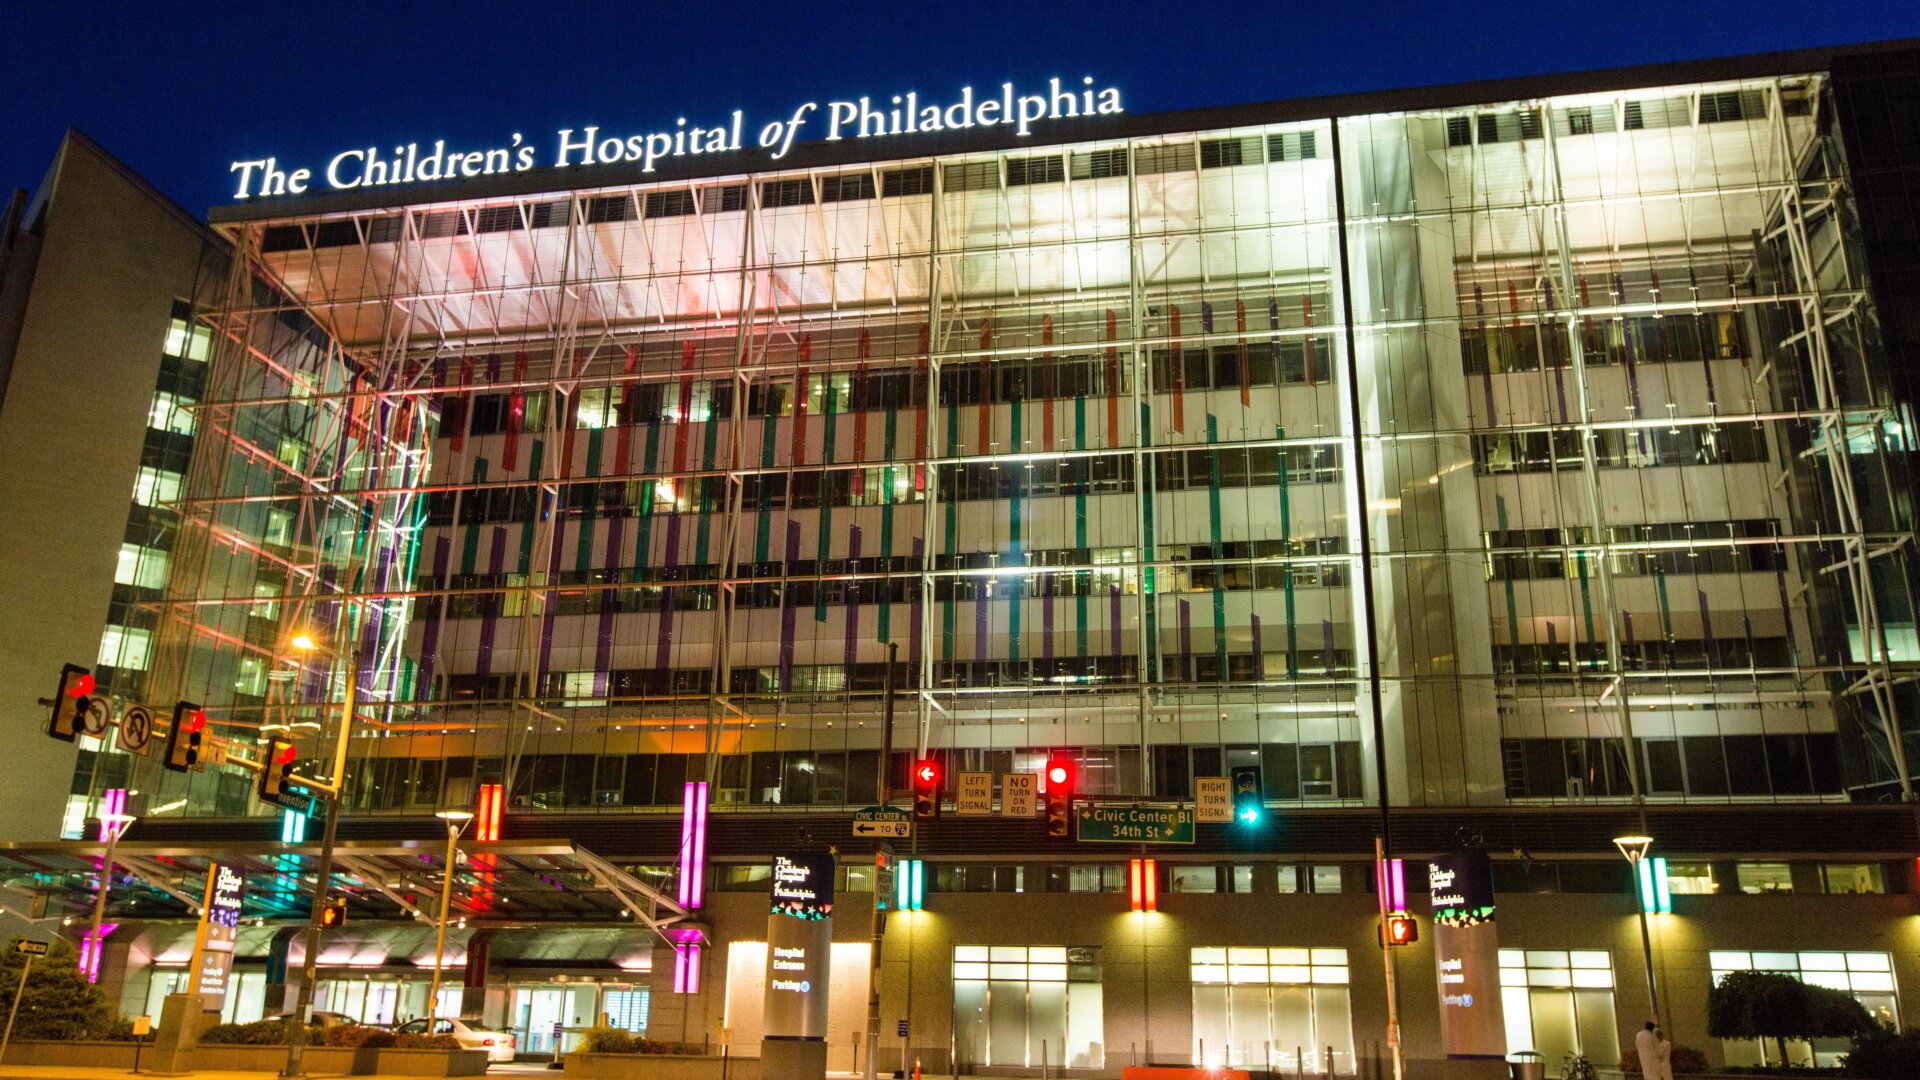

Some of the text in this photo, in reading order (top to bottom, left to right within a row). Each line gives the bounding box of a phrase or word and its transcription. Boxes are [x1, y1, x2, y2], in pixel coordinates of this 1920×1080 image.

[230, 77, 1124, 199] The Children's Hospital of Philadelphia
[965, 776, 985, 785] LEFT
[1010, 777, 1029, 787] NO
[1201, 782, 1226, 791] RIGHT
[965, 789, 986, 798] TURN
[1009, 788, 1030, 796] TURN
[1203, 795, 1226, 804] TURN
[960, 801, 989, 810] SIGNAL
[1010, 806, 1027, 814] RED
[855, 812, 873, 821] CIVIC
[874, 812, 900, 821] CENTER
[1094, 809, 1191, 824] Civic Center Bl
[1199, 807, 1230, 817] SIGNAL
[880, 825, 906, 835] TO 76
[1112, 825, 1159, 838] 34th St
[776, 856, 792, 866] The
[774, 888, 816, 901] Philadelphia
[774, 947, 805, 959] Hospital
[773, 959, 806, 971] Entrance
[772, 979, 801, 992] Parking
